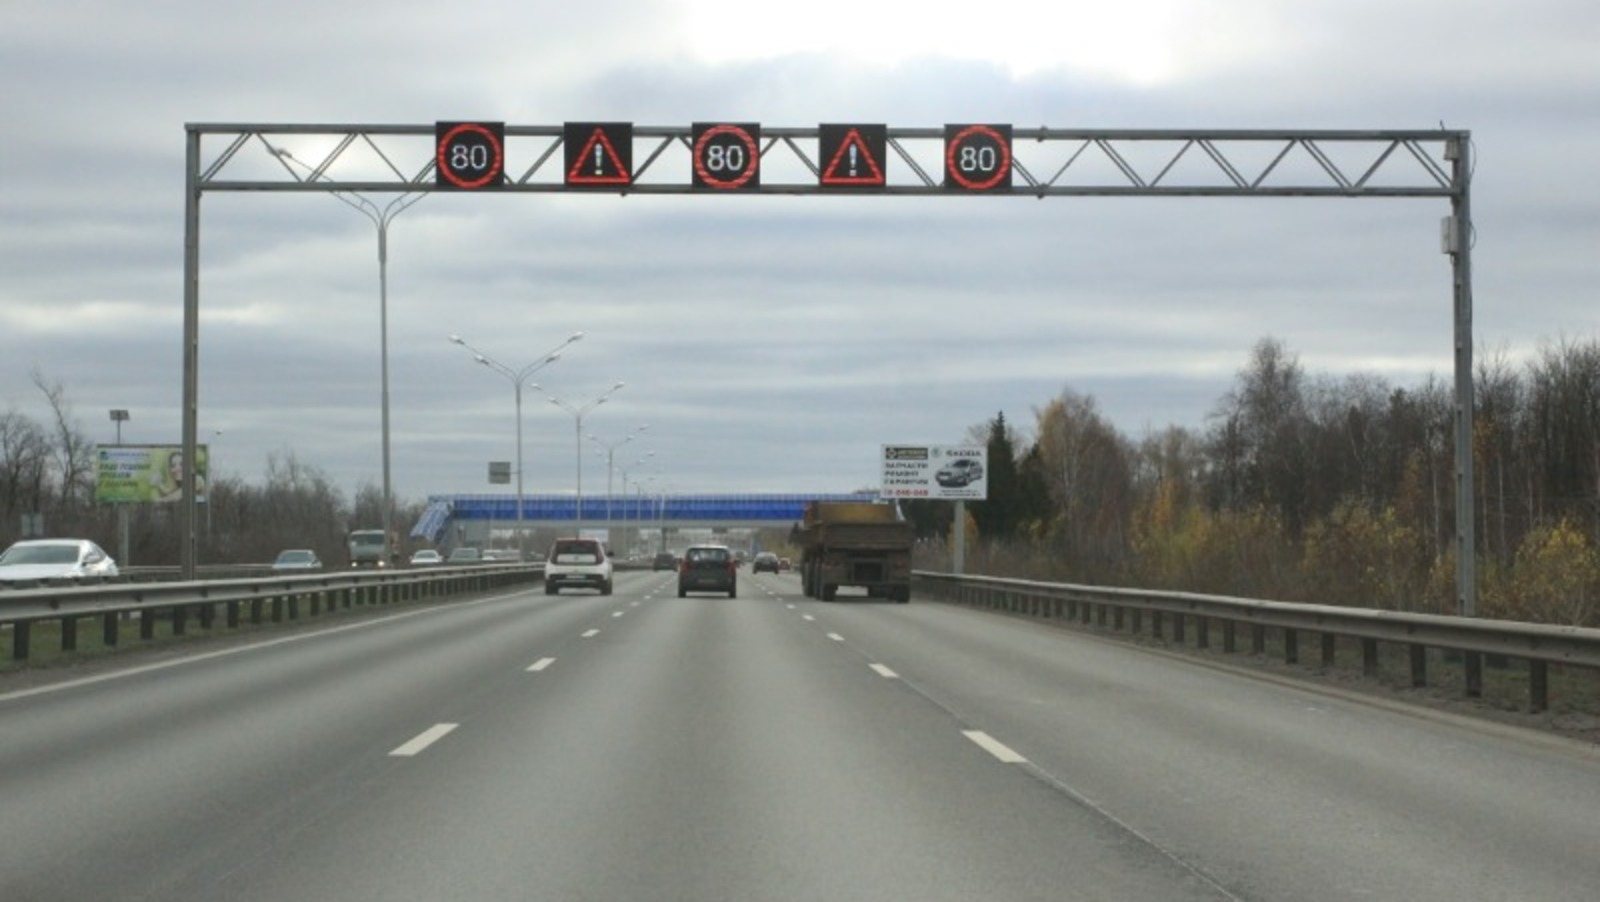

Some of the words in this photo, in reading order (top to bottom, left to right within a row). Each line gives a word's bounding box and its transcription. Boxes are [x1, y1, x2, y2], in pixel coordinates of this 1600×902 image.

[452, 145, 487, 169] 80
[707, 145, 743, 170] 80
[960, 146, 996, 171] 80
